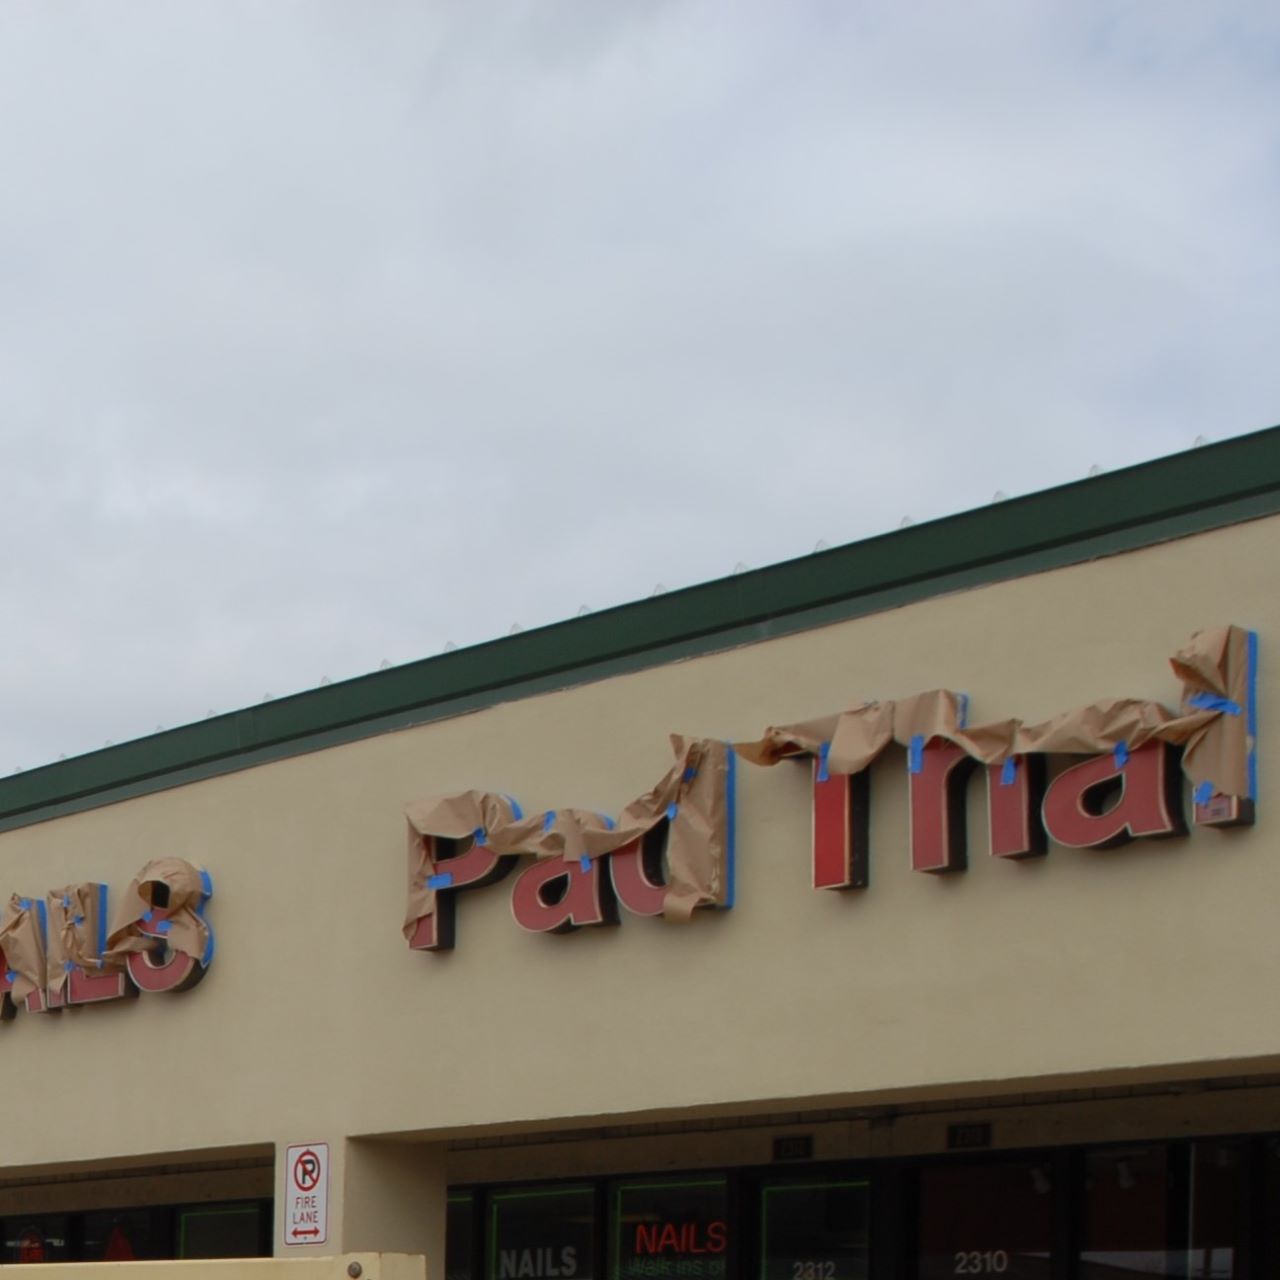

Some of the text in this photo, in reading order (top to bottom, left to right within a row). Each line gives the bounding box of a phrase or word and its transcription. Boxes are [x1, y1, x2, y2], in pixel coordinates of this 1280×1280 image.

[752, 628, 1257, 891] Tha
[295, 1196, 317, 1208] FIRE
[293, 1211, 318, 1224] LANE
[635, 1219, 727, 1255] NAILS
[500, 1246, 577, 1279] NAILS
[954, 1250, 1008, 1273] 2310
